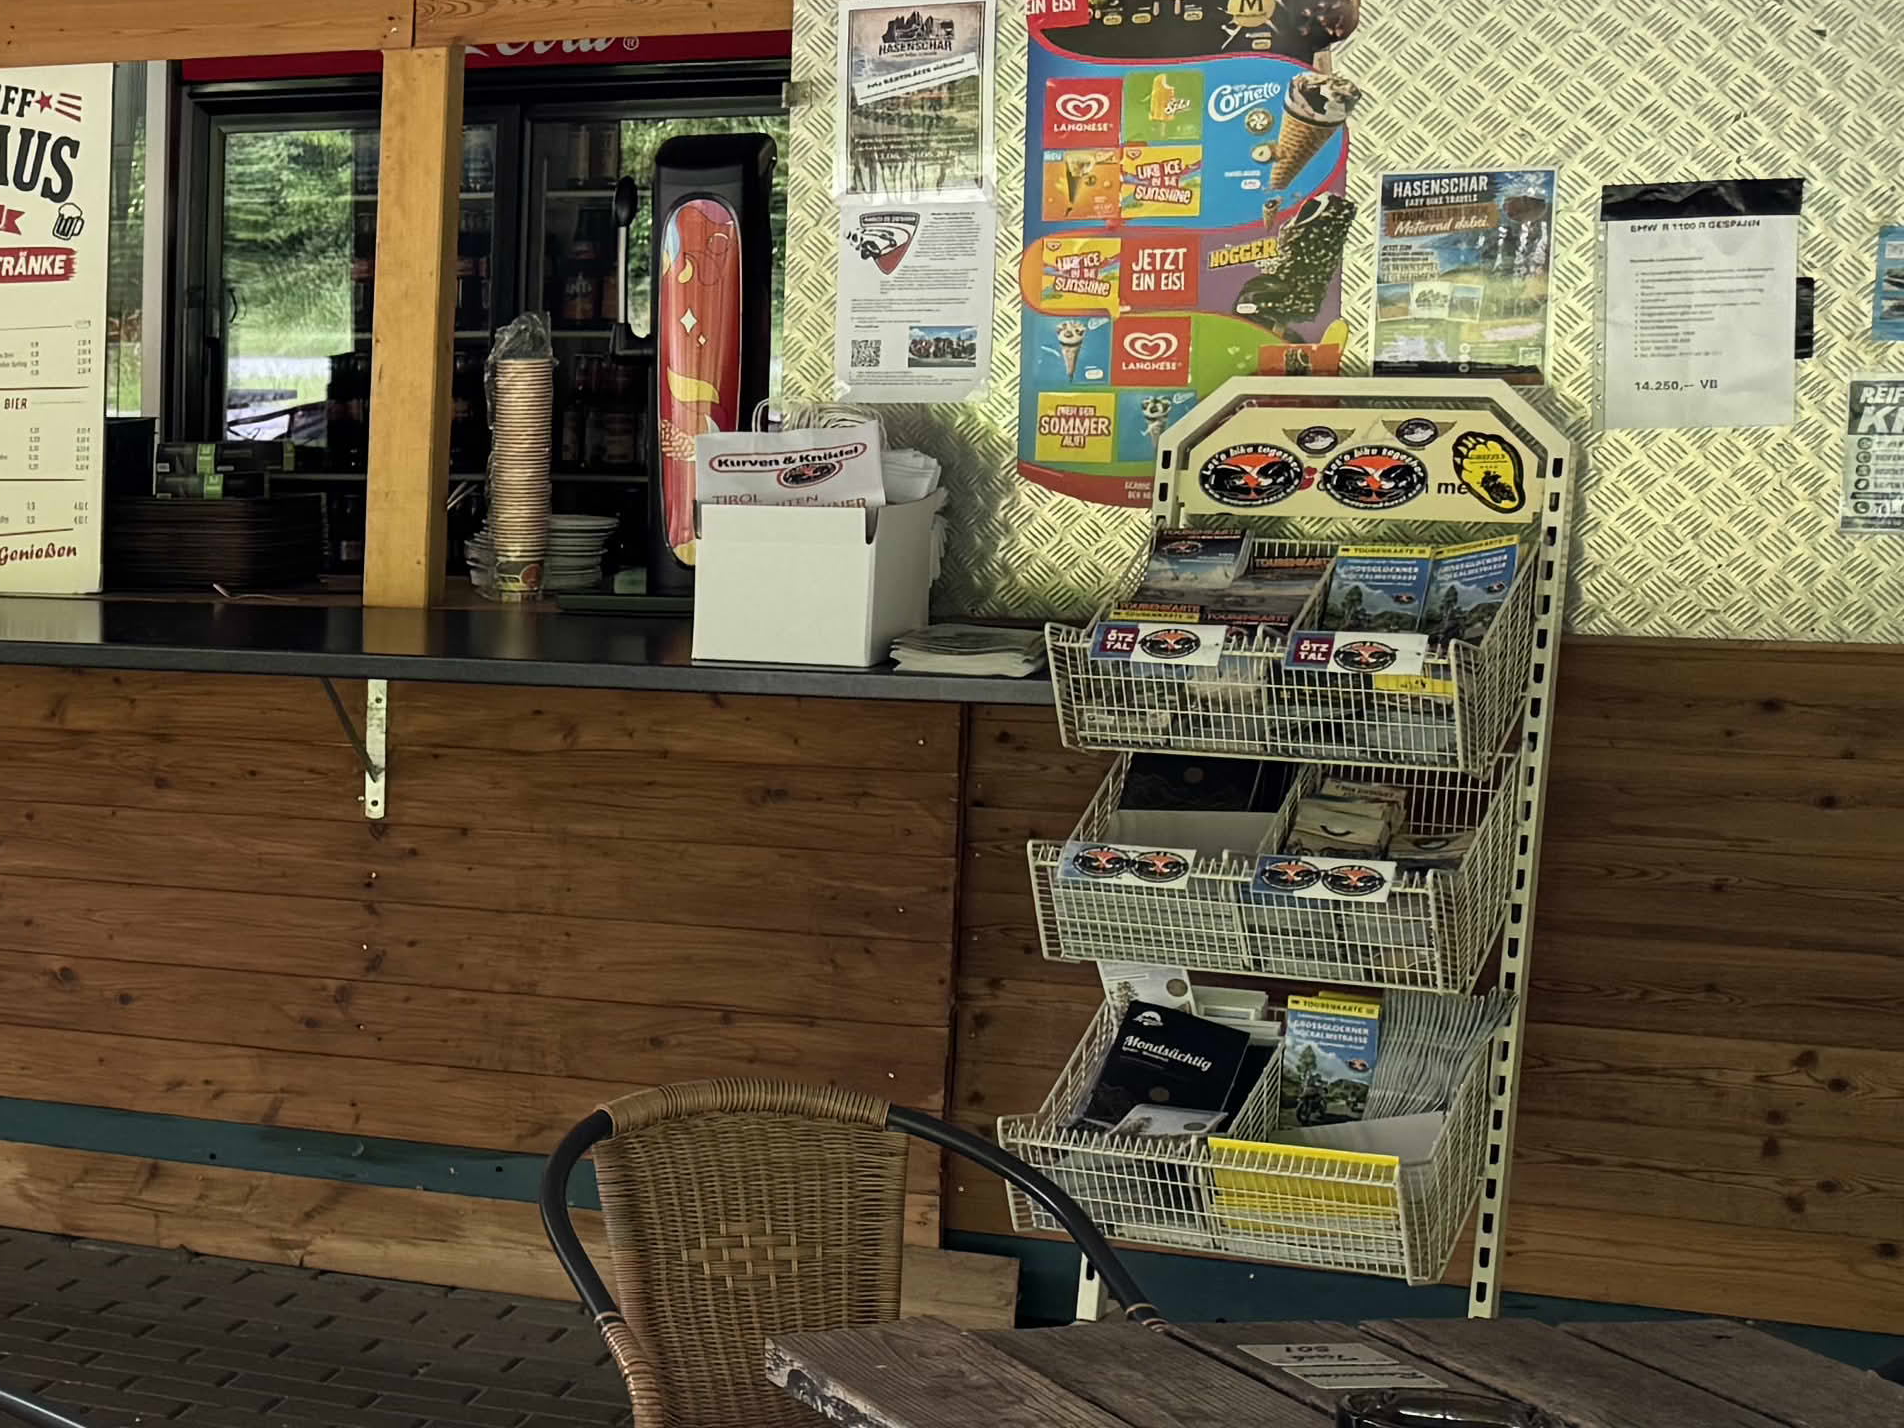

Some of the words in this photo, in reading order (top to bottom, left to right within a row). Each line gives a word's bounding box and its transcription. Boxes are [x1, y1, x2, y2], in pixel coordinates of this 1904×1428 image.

[878, 40, 952, 56] HASENSCHAR
[1207, 82, 1281, 122] Cornetto
[1053, 122, 1109, 133] LANGNESE
[1164, 159, 1182, 175] ICE
[1393, 175, 1489, 199] HASENSCHAR
[1394, 217, 1453, 236] Motorrad
[1629, 223, 1658, 233] BMW
[1708, 219, 1761, 229] GESPANN
[1083, 251, 1101, 267] ICE
[1131, 248, 1188, 271] JETZT
[1131, 273, 1155, 291] EIN
[1122, 361, 1177, 371] LANGNESE
[3, 397, 28, 410] BIER
[1040, 416, 1110, 436] SOMMER
[717, 458, 779, 468] Kurven
[783, 455, 797, 465] &
[1254, 557, 1330, 569] TOURENKART
[1107, 630, 1135, 643] ÖTZ
[1105, 642, 1132, 651] TAL
[1300, 639, 1330, 652] ÖTZ
[1298, 651, 1327, 661] TAL
[1123, 1035, 1213, 1072] Mondsüchtig
